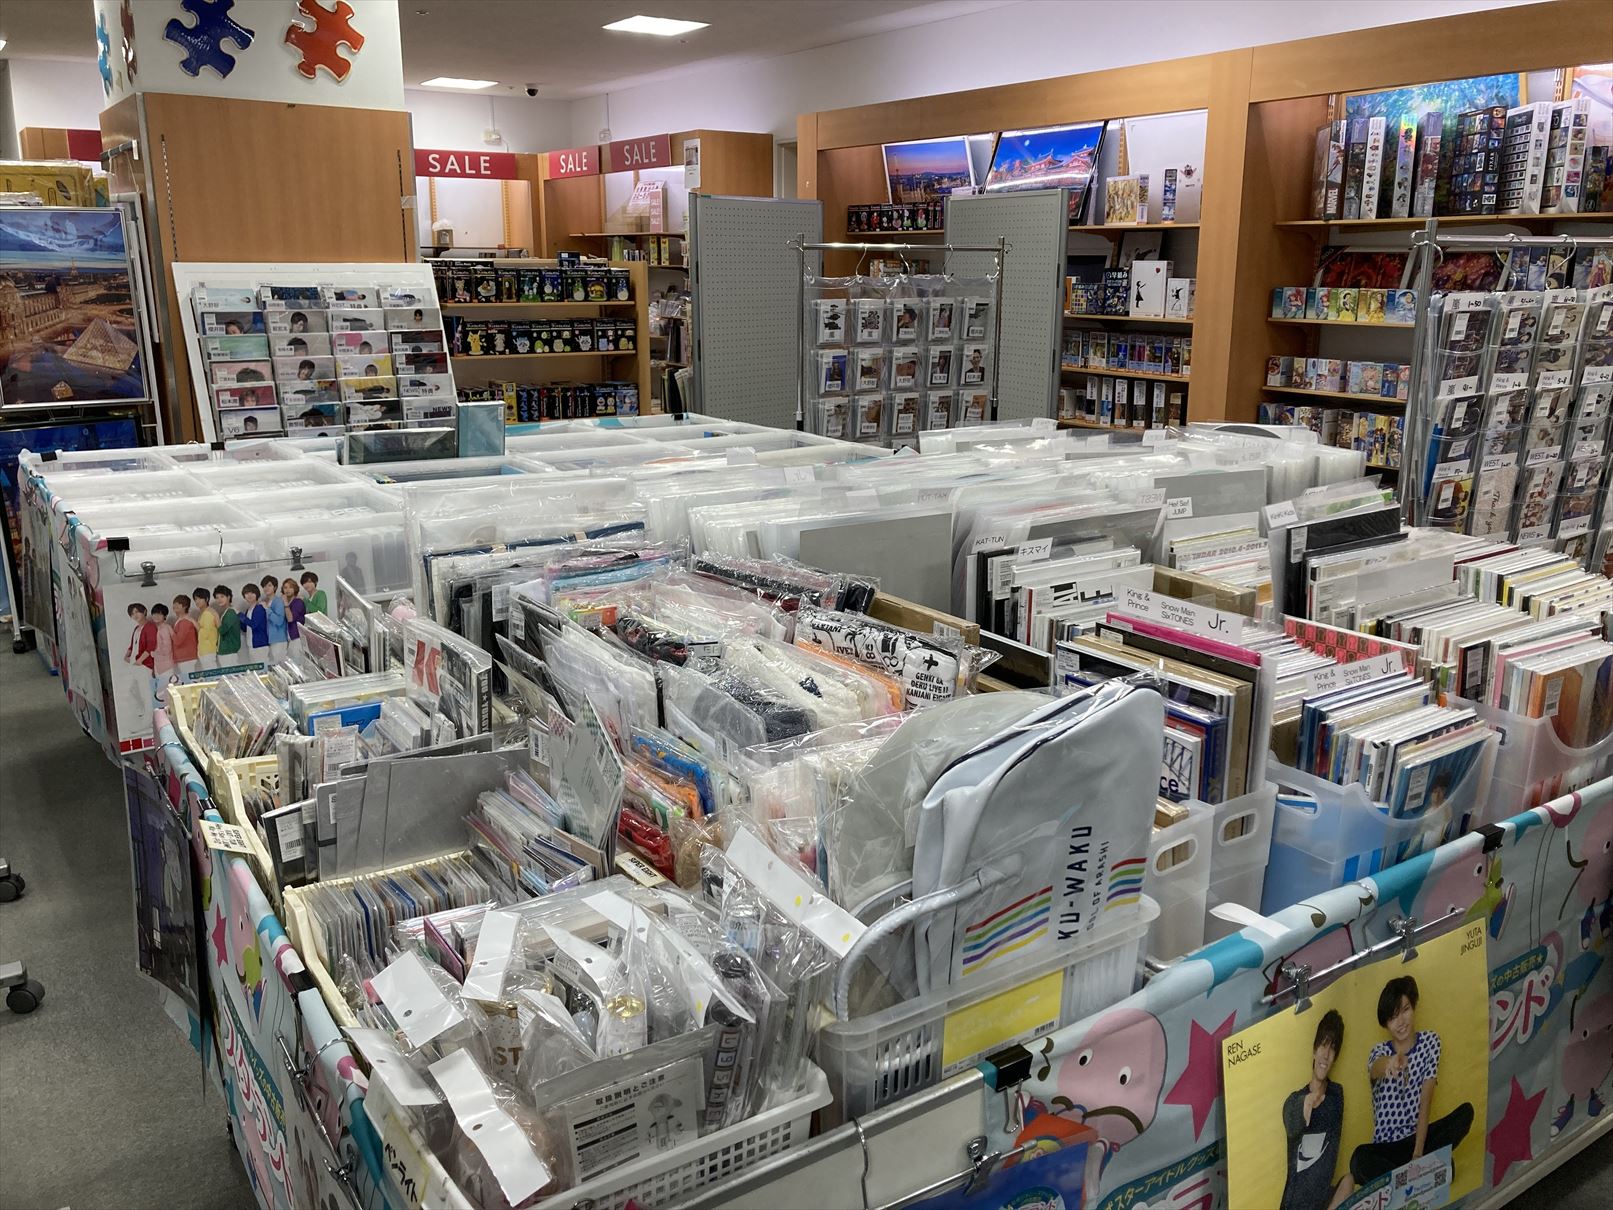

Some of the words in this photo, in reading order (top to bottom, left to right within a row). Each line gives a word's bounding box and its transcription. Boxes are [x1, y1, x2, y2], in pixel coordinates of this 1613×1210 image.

[623, 141, 657, 166] SALE
[428, 154, 491, 175] SALE
[559, 152, 587, 174] SALE
[1326, 189, 1339, 215] MARVEL
[975, 535, 1005, 546] KAT-TUN
[1020, 544, 1049, 557] キスマイ
[1127, 588, 1143, 601] King
[1144, 593, 1150, 602] &
[1127, 599, 1149, 611] Prince
[1161, 601, 1180, 613] Snow
[1180, 606, 1196, 617] Man
[1161, 611, 1194, 626] SixTONES
[1208, 613, 1229, 633] Jr.
[1343, 668, 1358, 677] Snow
[1359, 664, 1371, 672] Man
[1381, 657, 1396, 674] Jr.
[915, 672, 934, 684] GENKI
[1314, 672, 1329, 681] King
[1330, 669, 1336, 677] &
[911, 680, 928, 691] DERU
[1317, 681, 1336, 691] Prince
[905, 687, 931, 701] KANJANI
[629, 857, 645, 869] SUPER
[1095, 841, 1110, 886] ARASHI
[1092, 891, 1101, 906] OF
[1466, 926, 1482, 939] YUTA
[1227, 1040, 1243, 1056] REN
[1228, 1043, 1261, 1069] NAGASE
[596, 1074, 665, 1105] 取扱説明とご注意
